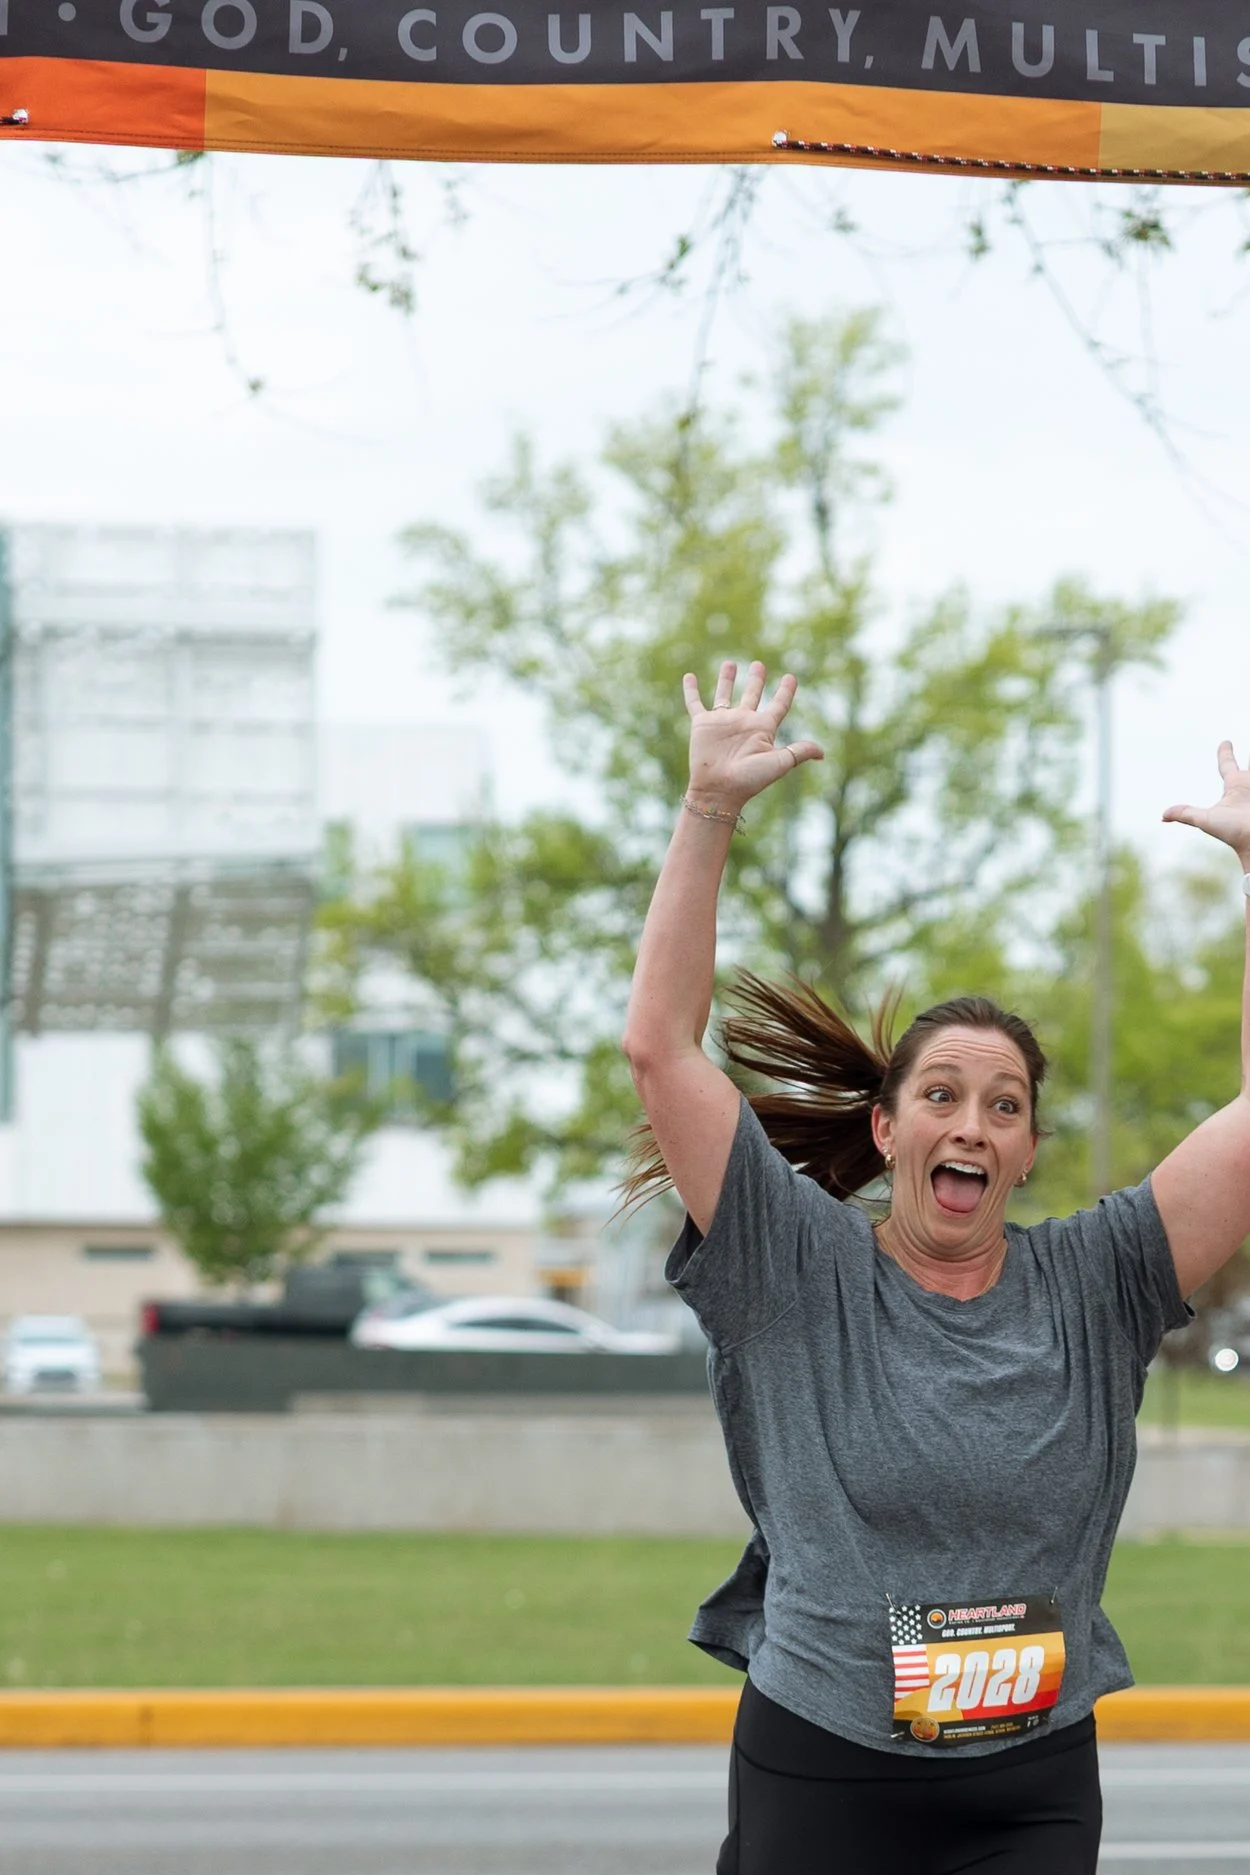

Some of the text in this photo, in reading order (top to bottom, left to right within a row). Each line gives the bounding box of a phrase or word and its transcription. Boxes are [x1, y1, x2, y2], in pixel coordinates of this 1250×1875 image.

[118, 0, 349, 62] GOD,
[397, 6, 875, 69] COUNTRY,
[948, 1603, 1027, 1621] HEARTLAND
[927, 1645, 1045, 1712] 2028
